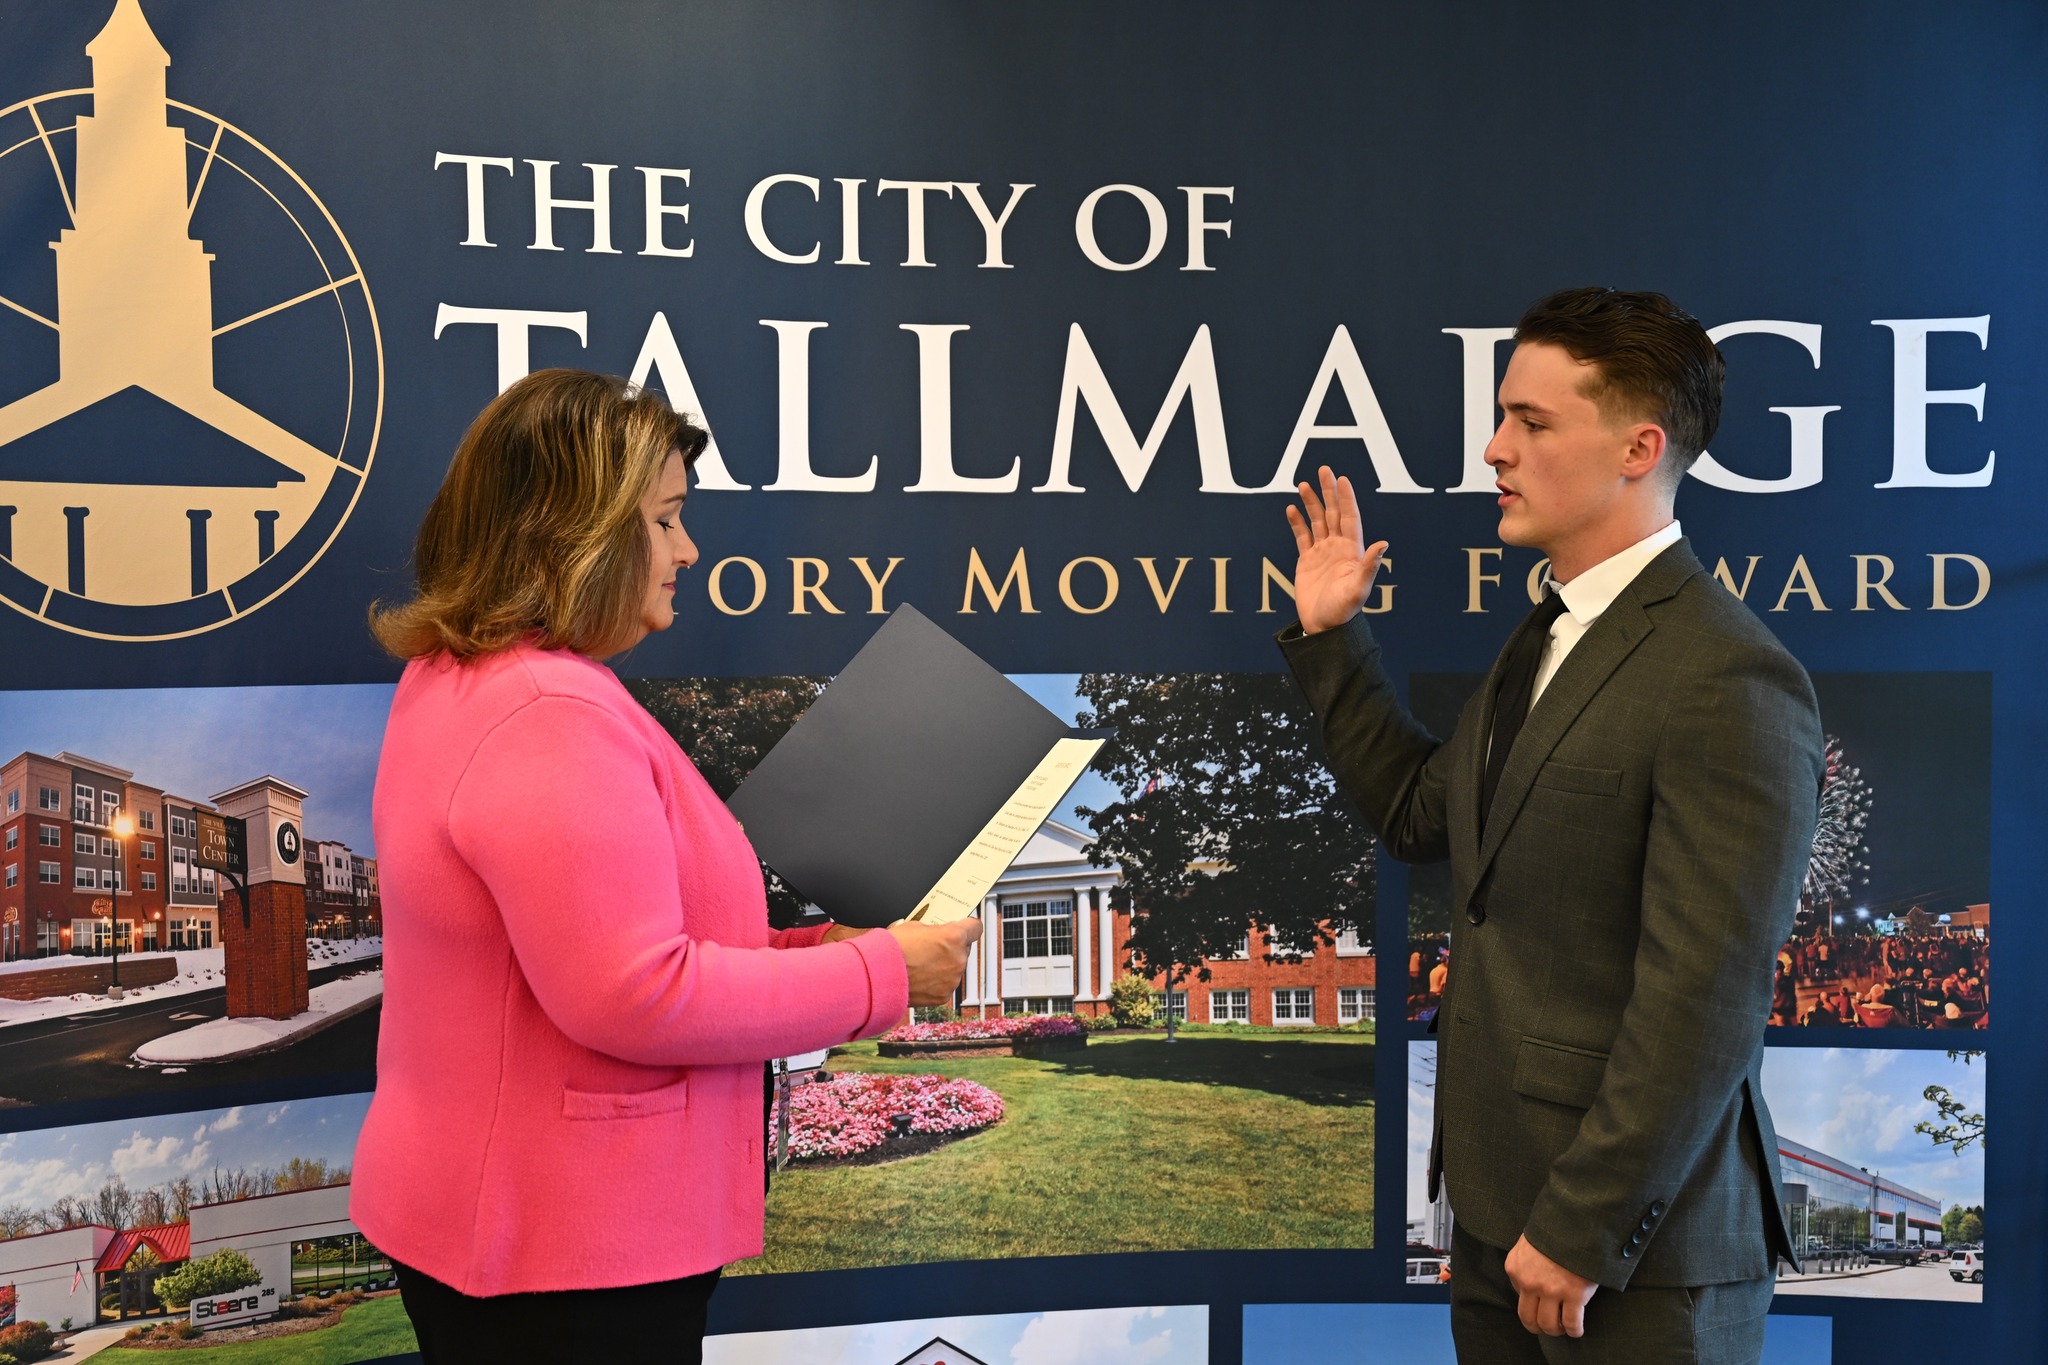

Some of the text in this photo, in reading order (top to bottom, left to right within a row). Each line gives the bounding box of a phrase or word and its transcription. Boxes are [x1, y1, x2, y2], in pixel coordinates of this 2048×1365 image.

[433, 151, 1235, 272] THE CITY OF
[207, 829, 235, 848] TOWN
[202, 845, 240, 865] CENTER
[196, 1288, 275, 1319] Steere 285
